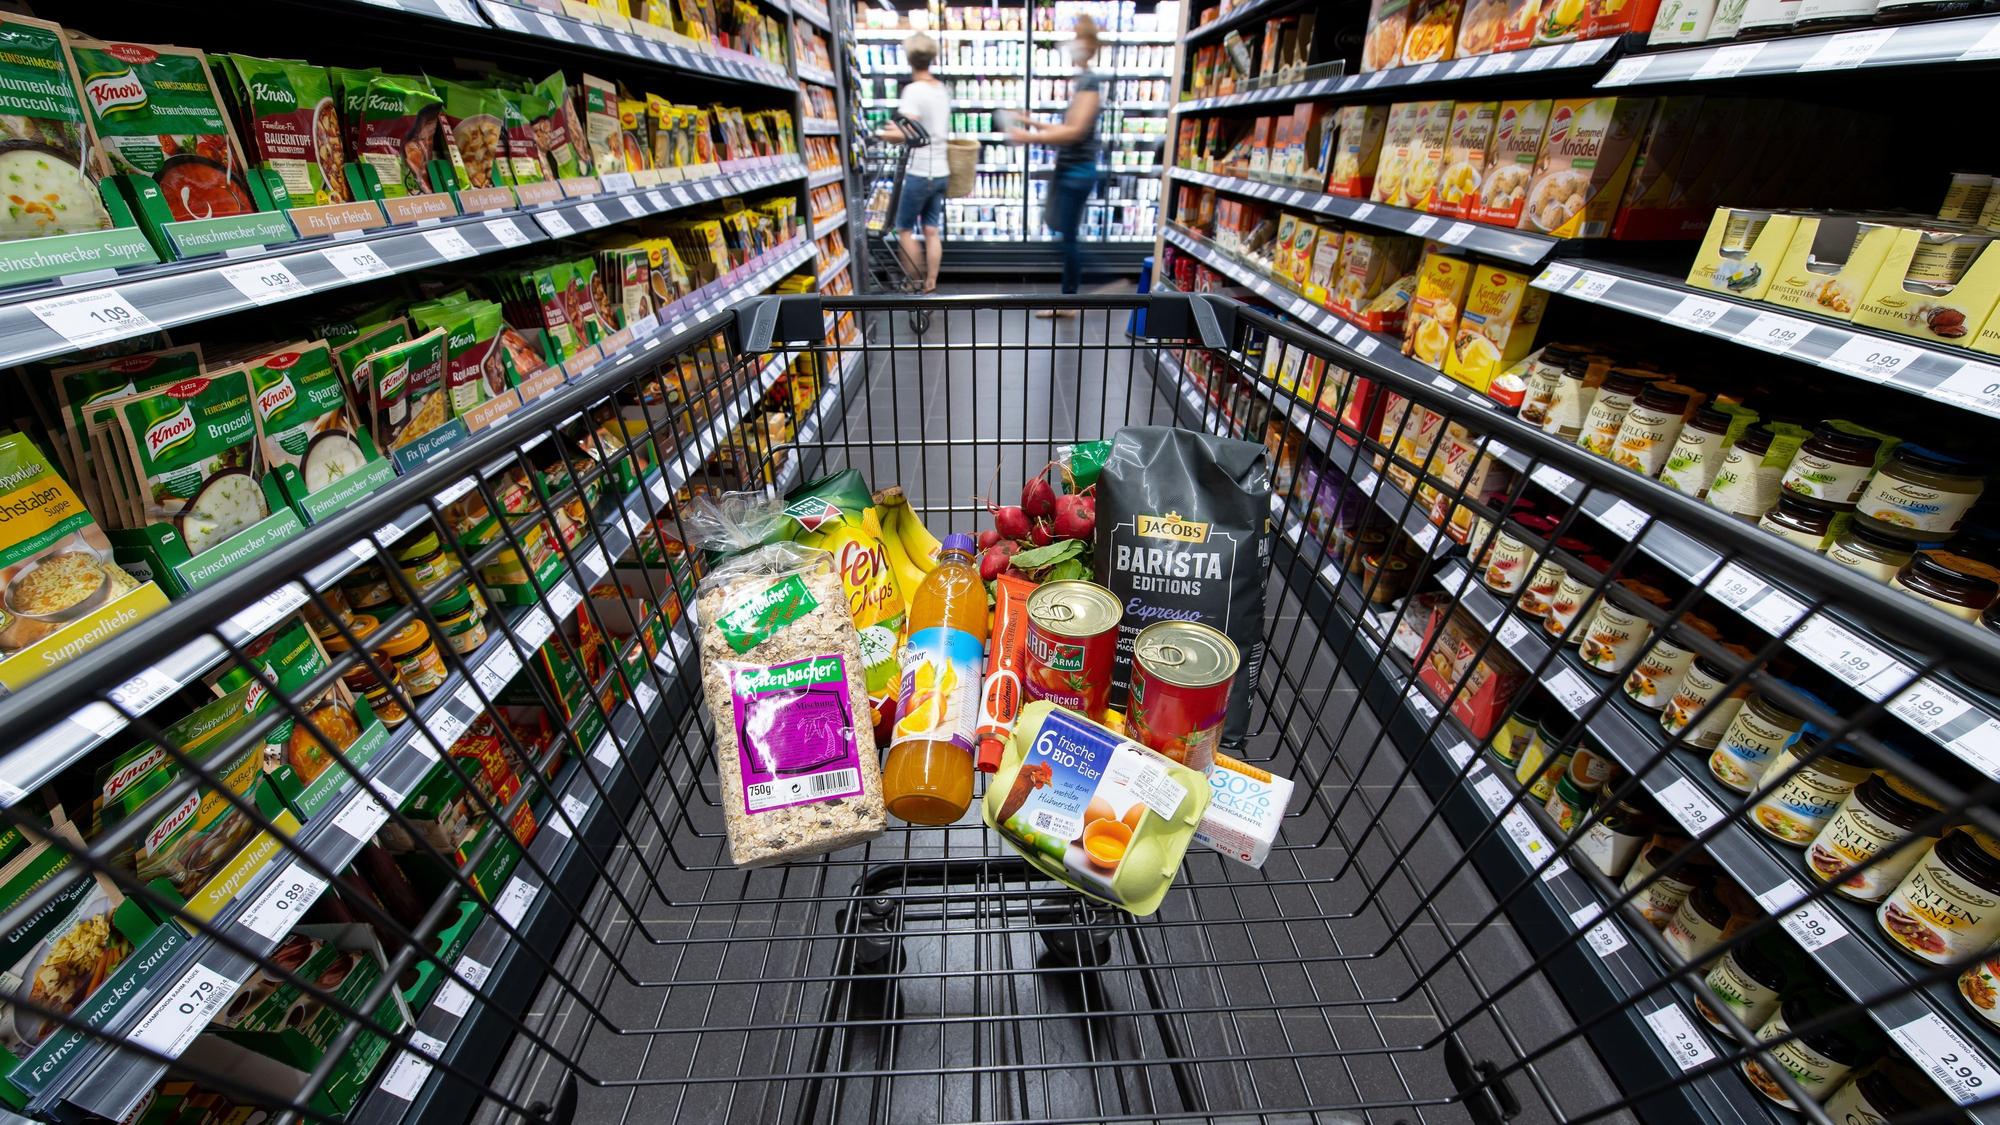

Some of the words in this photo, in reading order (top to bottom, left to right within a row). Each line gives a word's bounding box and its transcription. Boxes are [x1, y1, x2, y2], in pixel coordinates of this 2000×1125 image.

[0, 75, 73, 98] lumenkohl
[89, 81, 143, 107] Knorr
[252, 82, 296, 104] Knorr
[0, 95, 59, 112] roccoli
[150, 104, 219, 117] Strauchtomaten
[368, 94, 405, 112] Knorr
[264, 132, 311, 147] BAUERNTOPF
[1460, 134, 1485, 150] Knödel
[1576, 127, 1604, 138] Semmel
[1506, 136, 1539, 153] Knödel
[1560, 138, 1600, 157] Knödel
[309, 215, 324, 228] Fix
[325, 212, 341, 231] für
[343, 209, 373, 224] Fleisch
[399, 205, 412, 217] Fix
[413, 203, 425, 219] für
[427, 201, 447, 214] Fleisch
[178, 225, 256, 247] Feinschmecker
[258, 221, 288, 238] Suppe
[0, 249, 101, 272] einschmecker
[107, 241, 147, 259] Suppe
[353, 253, 377, 266] 0.79
[260, 272, 290, 287] 0.99
[1474, 284, 1512, 305] Kartoffel
[1771, 283, 1818, 301] KRUSTENTIER-
[1780, 294, 1801, 304] PASTE
[90, 305, 130, 324] 1.09
[1692, 308, 1716, 320] 0.99
[1860, 303, 1920, 322] BRATEN-PASTE
[448, 333, 475, 349] Knorr
[1769, 328, 1798, 342] 0.99
[1865, 351, 1901, 369] 0.99
[382, 367, 408, 391] Knorr
[452, 365, 480, 382] ROULADEN
[180, 382, 196, 393] Extra
[259, 382, 295, 412] Knorr
[207, 409, 252, 439] Broccoli
[475, 412, 486, 424] Fix
[1628, 408, 1667, 426] Lacroix
[148, 415, 194, 449] Knorr
[406, 447, 419, 461] Fix
[419, 437, 435, 457] für
[430, 427, 457, 447] Gemüse
[1812, 471, 1837, 483] FOND
[310, 480, 367, 514] Feinschmecker
[368, 465, 390, 482] Suppe
[1892, 484, 1939, 500] Lacroix
[44, 500, 71, 517] Suppe
[1880, 491, 1907, 505] FISCH
[1909, 499, 1941, 513] FOND
[6, 549, 18, 560] mit
[20, 538, 43, 555] vielen
[43, 528, 60, 546] Nudeln
[60, 524, 71, 536] von
[71, 516, 85, 529] A-Z
[1142, 519, 1202, 538] JACOBS
[189, 537, 266, 583] Feinschmecker
[267, 518, 299, 541] Suppe
[1830, 549, 1861, 566] Lacroix
[1116, 544, 1223, 580] BARISTA
[1132, 577, 1202, 596] EDITIONS
[1723, 578, 1748, 596] 1.99
[850, 581, 893, 616] Chips
[1126, 597, 1203, 622] Espresso
[41, 606, 138, 667] Suppenliebe
[1503, 627, 1518, 640] 2.99
[1049, 654, 1081, 668] PARMA
[1116, 656, 1130, 665] FLAT
[1839, 650, 1871, 672] 1.99
[1044, 692, 1079, 706] STÜCKIG
[1569, 690, 1586, 706] 2.99
[1908, 692, 1944, 717] 1.99
[439, 715, 457, 734] 1.79
[1738, 711, 1783, 741] Lacroix
[362, 730, 385, 755] Suppe
[1036, 730, 1058, 756] 6
[1057, 735, 1096, 762] frische
[1727, 735, 1757, 760] FOND
[1730, 723, 1770, 756] FISCH
[106, 748, 165, 797] Knorr
[1052, 748, 1101, 781] BIO-Eier
[748, 783, 771, 797] 750g
[1054, 789, 1079, 802] mobilen
[1075, 784, 1090, 794] dem
[1210, 769, 1273, 808] 30%
[1492, 790, 1506, 805] 7.29
[1779, 780, 1841, 810] FISCH
[1212, 802, 1263, 828] RISCHGARANTIE
[1684, 802, 1708, 824] 2.99
[1781, 792, 1825, 817] FOND
[150, 795, 198, 851] Knorr
[514, 817, 535, 841] Pack
[1515, 821, 1530, 837] 0.59
[492, 853, 510, 881] Soße
[69, 878, 91, 901] Sauce
[514, 882, 529, 901] 1.29
[1925, 863, 1998, 908] Lacroix
[276, 883, 305, 911] 0.89
[1911, 872, 1982, 927] ENTEN
[1909, 893, 1956, 927] FOND
[1795, 910, 1827, 938] 2.99
[1594, 926, 1613, 947] 2.99
[139, 934, 177, 976] Sauce
[141, 997, 174, 1030] CHAMPIGNON
[184, 968, 200, 987] SAUCE
[178, 981, 214, 1016] 0.79
[1676, 1032, 1699, 1059] 2.99
[1930, 1016, 1941, 1028] LAC
[1941, 1024, 1971, 1054] KALBS-FOND
[1970, 1051, 1988, 1070] 400ML
[1940, 1053, 1983, 1088] 2.99
